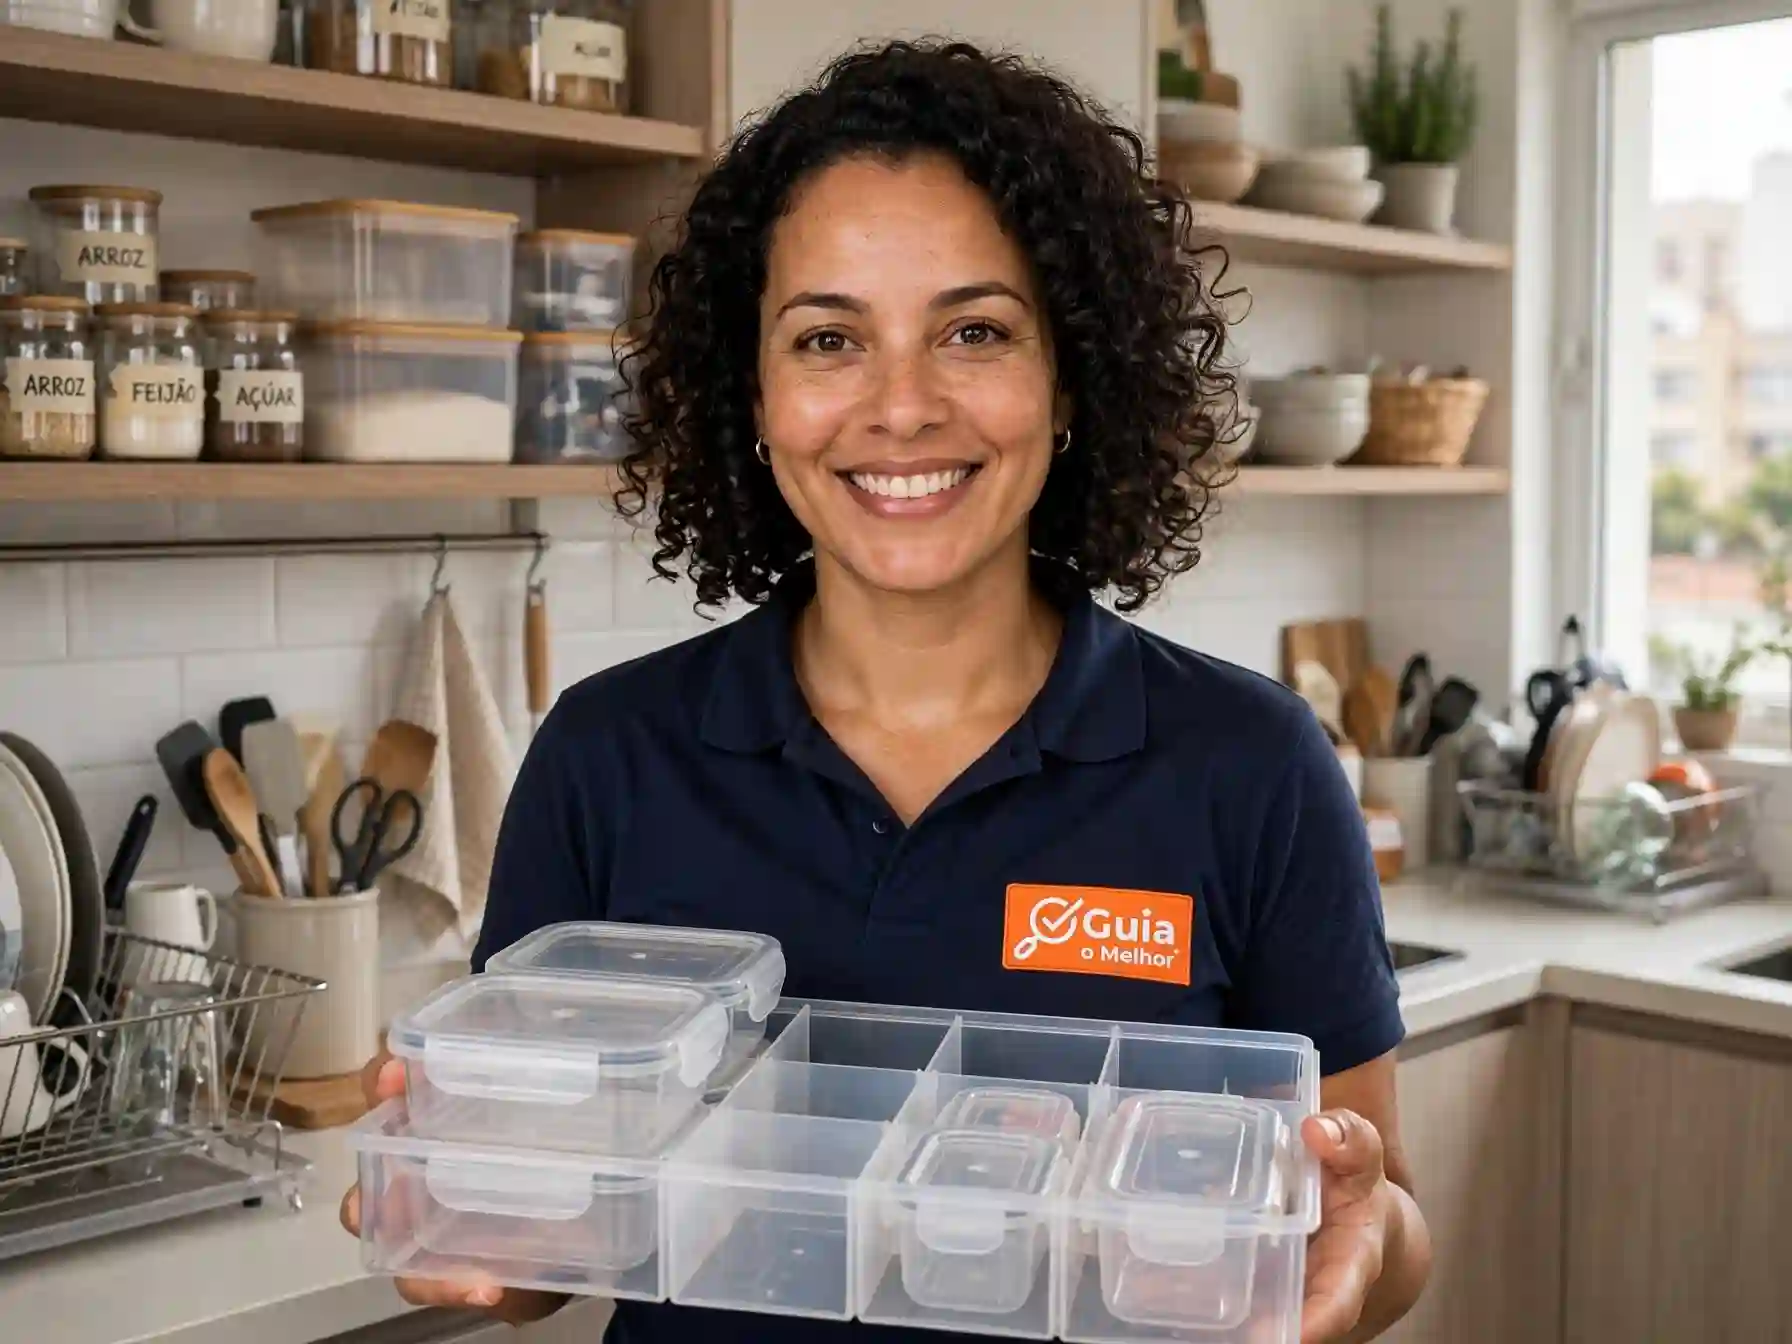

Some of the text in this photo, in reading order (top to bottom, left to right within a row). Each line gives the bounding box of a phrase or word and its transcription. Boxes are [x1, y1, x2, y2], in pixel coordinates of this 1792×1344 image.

[78, 245, 147, 268] ARROZ
[24, 374, 86, 397] ARROZ
[132, 378, 196, 403] FEIJÃO
[236, 381, 296, 411] AÇÚAR
[1082, 908, 1175, 945] Guia
[1081, 945, 1175, 969] o Melhor
